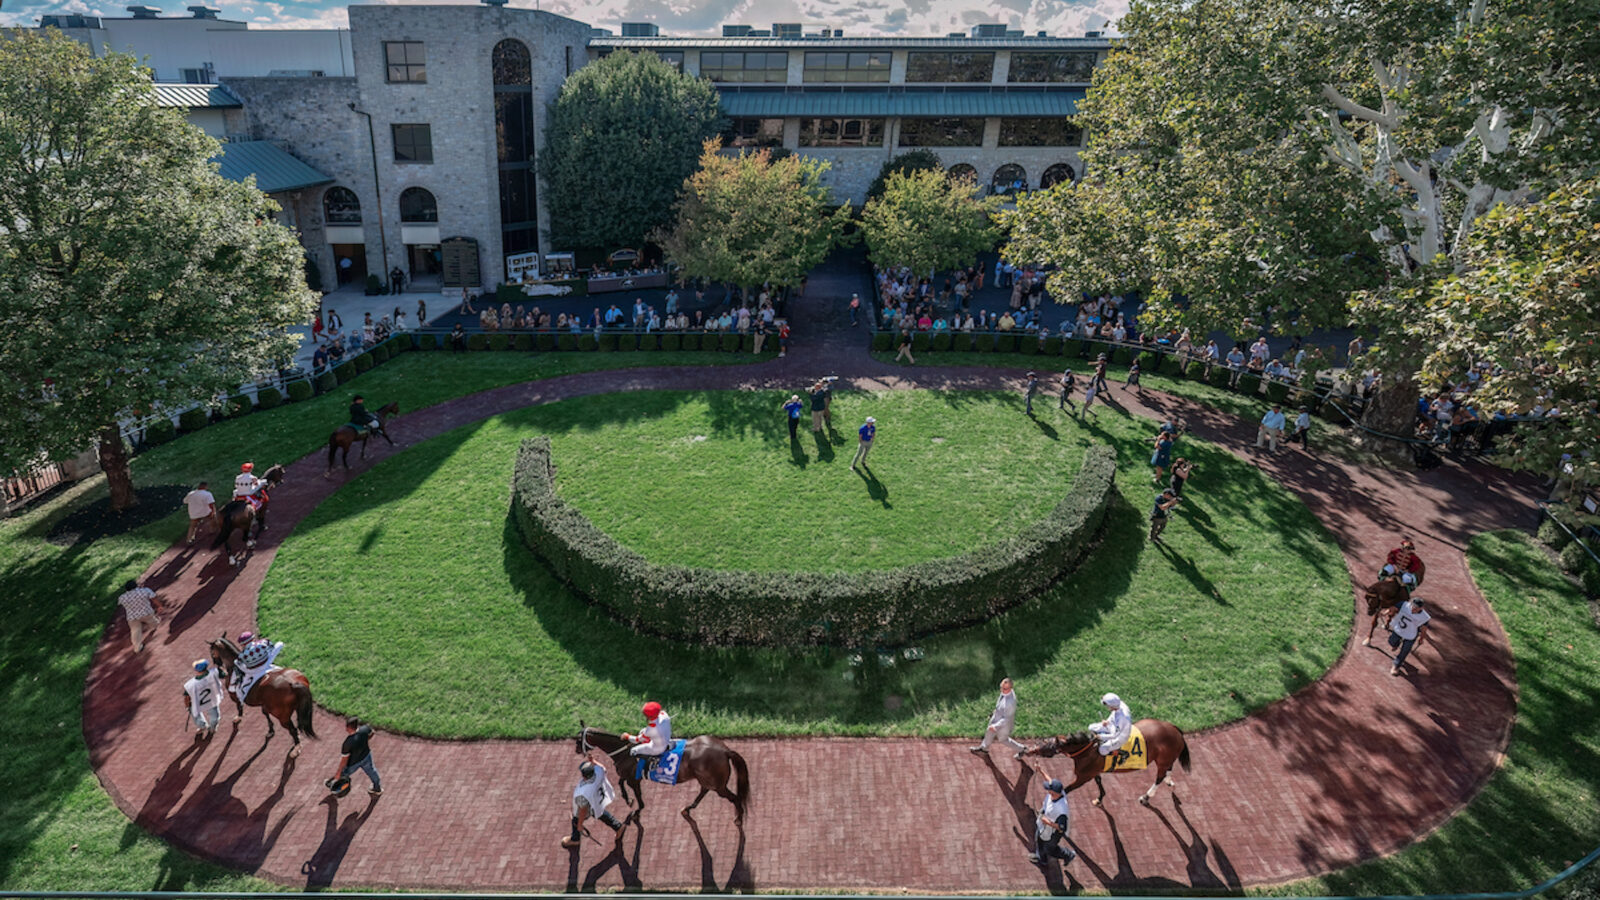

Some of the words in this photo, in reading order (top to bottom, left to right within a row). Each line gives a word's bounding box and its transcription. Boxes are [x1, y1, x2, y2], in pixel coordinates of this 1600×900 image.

[1399, 615, 1412, 629] 5
[199, 688, 212, 706] 2
[1131, 736, 1143, 757] 4
[664, 753, 679, 776] 3
